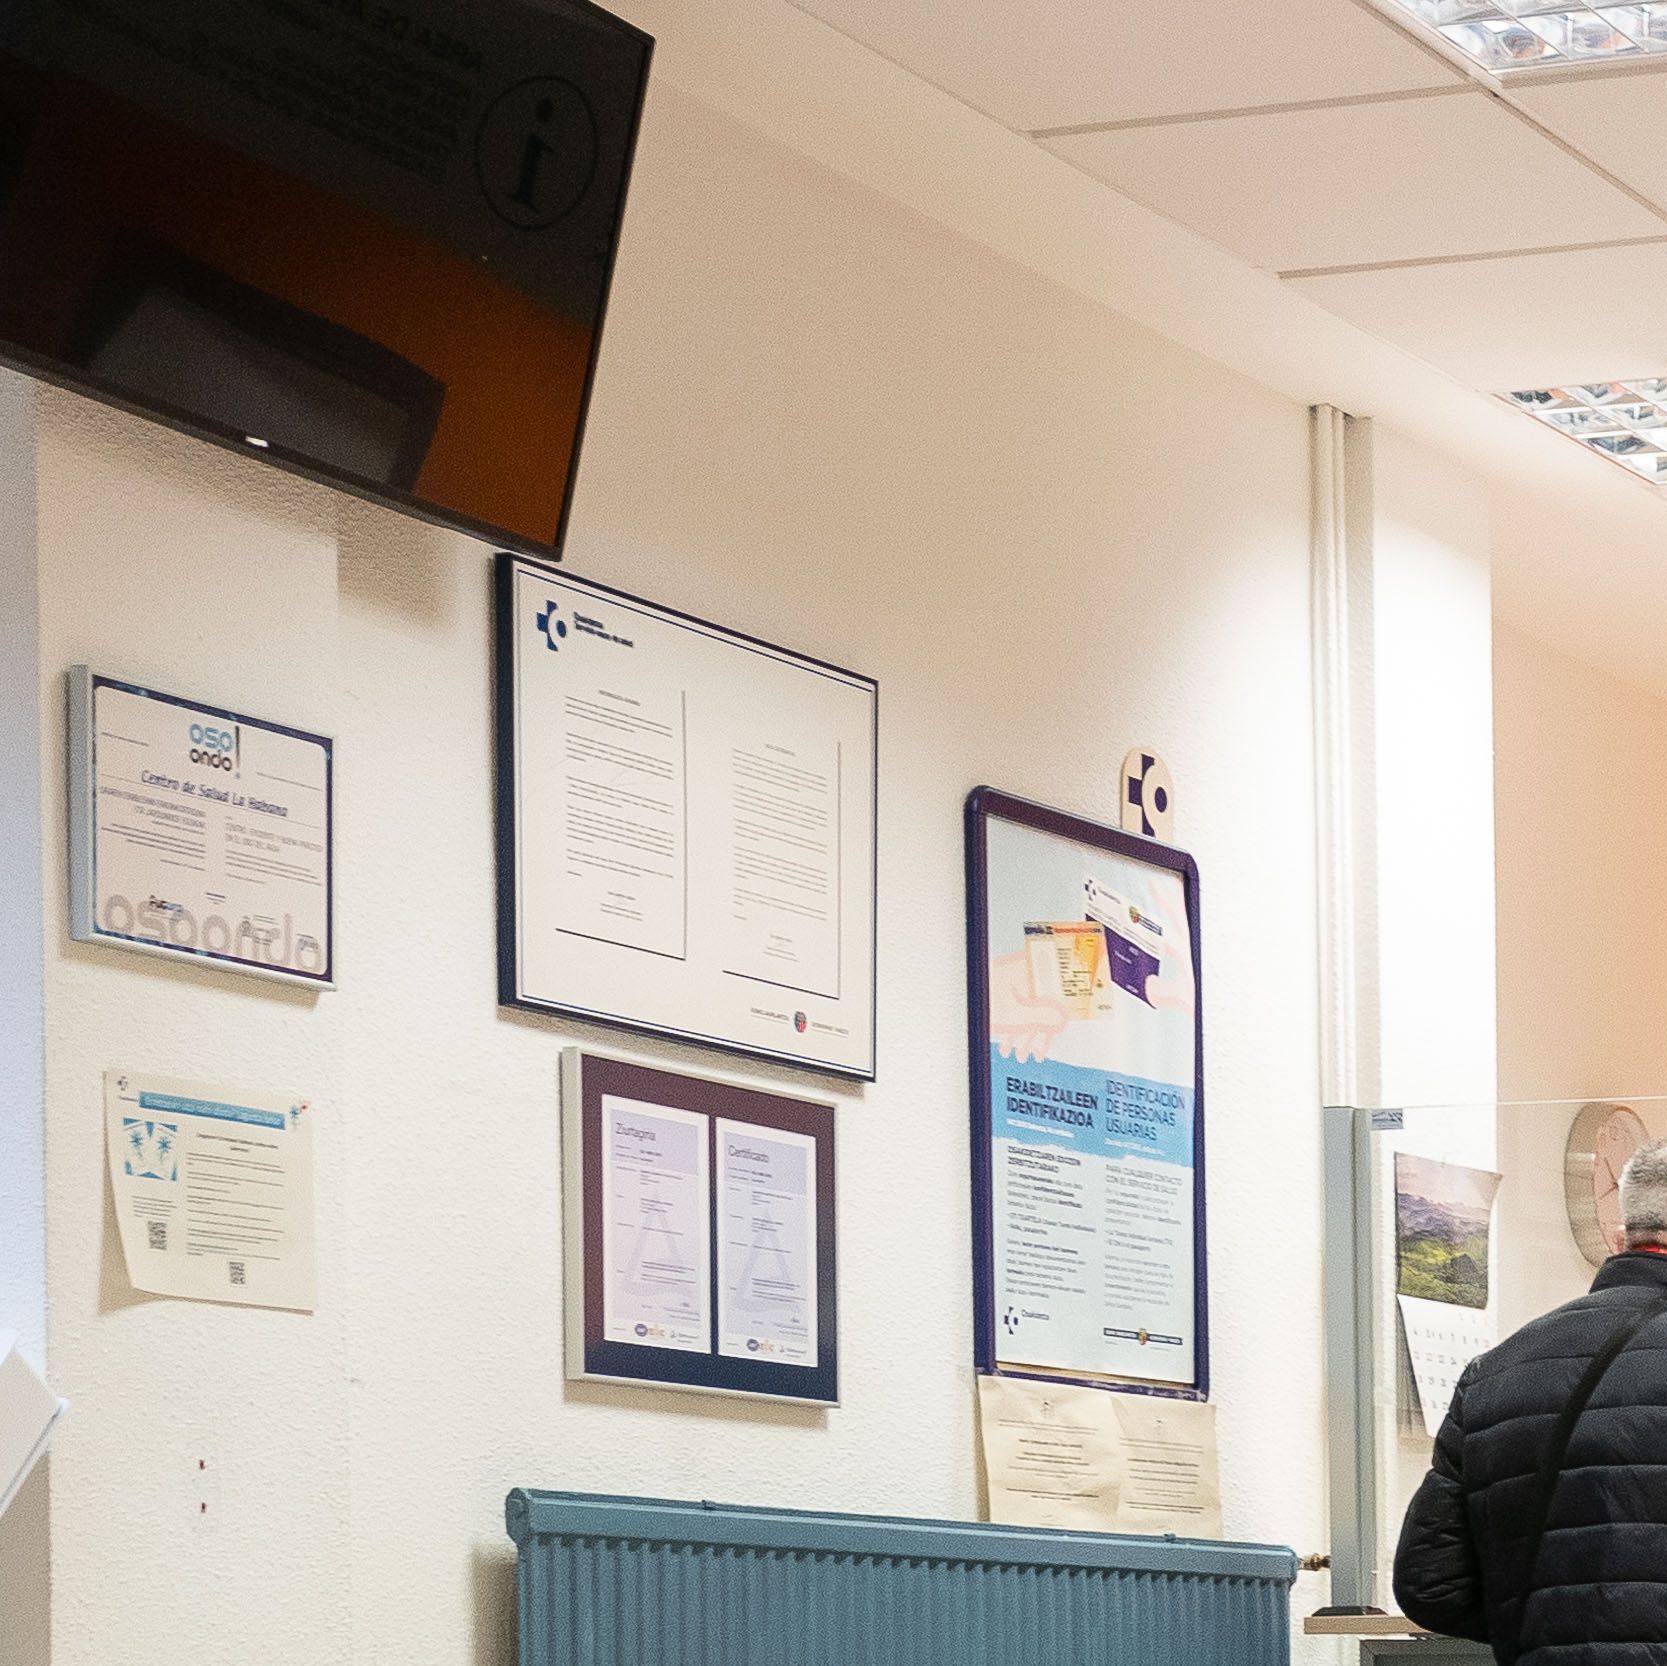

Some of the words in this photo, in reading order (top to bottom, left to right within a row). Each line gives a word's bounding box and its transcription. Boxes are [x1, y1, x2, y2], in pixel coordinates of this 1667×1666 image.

[189, 723, 233, 752] oso
[190, 748, 232, 771] ondo
[142, 770, 180, 790] Centro
[183, 780, 196, 795] de
[199, 784, 229, 803] Salud
[233, 792, 245, 807] La
[1006, 1077, 1099, 1110] ERABILTZAILEEN
[1106, 1079, 1185, 1110] IDENTIFICACIÓN
[1007, 1096, 1095, 1128] IDENTIFIKAZIOA
[1106, 1099, 1120, 1114] DE
[1121, 1103, 1175, 1127] PERSONAS
[1106, 1118, 1157, 1141] USUARIAS
